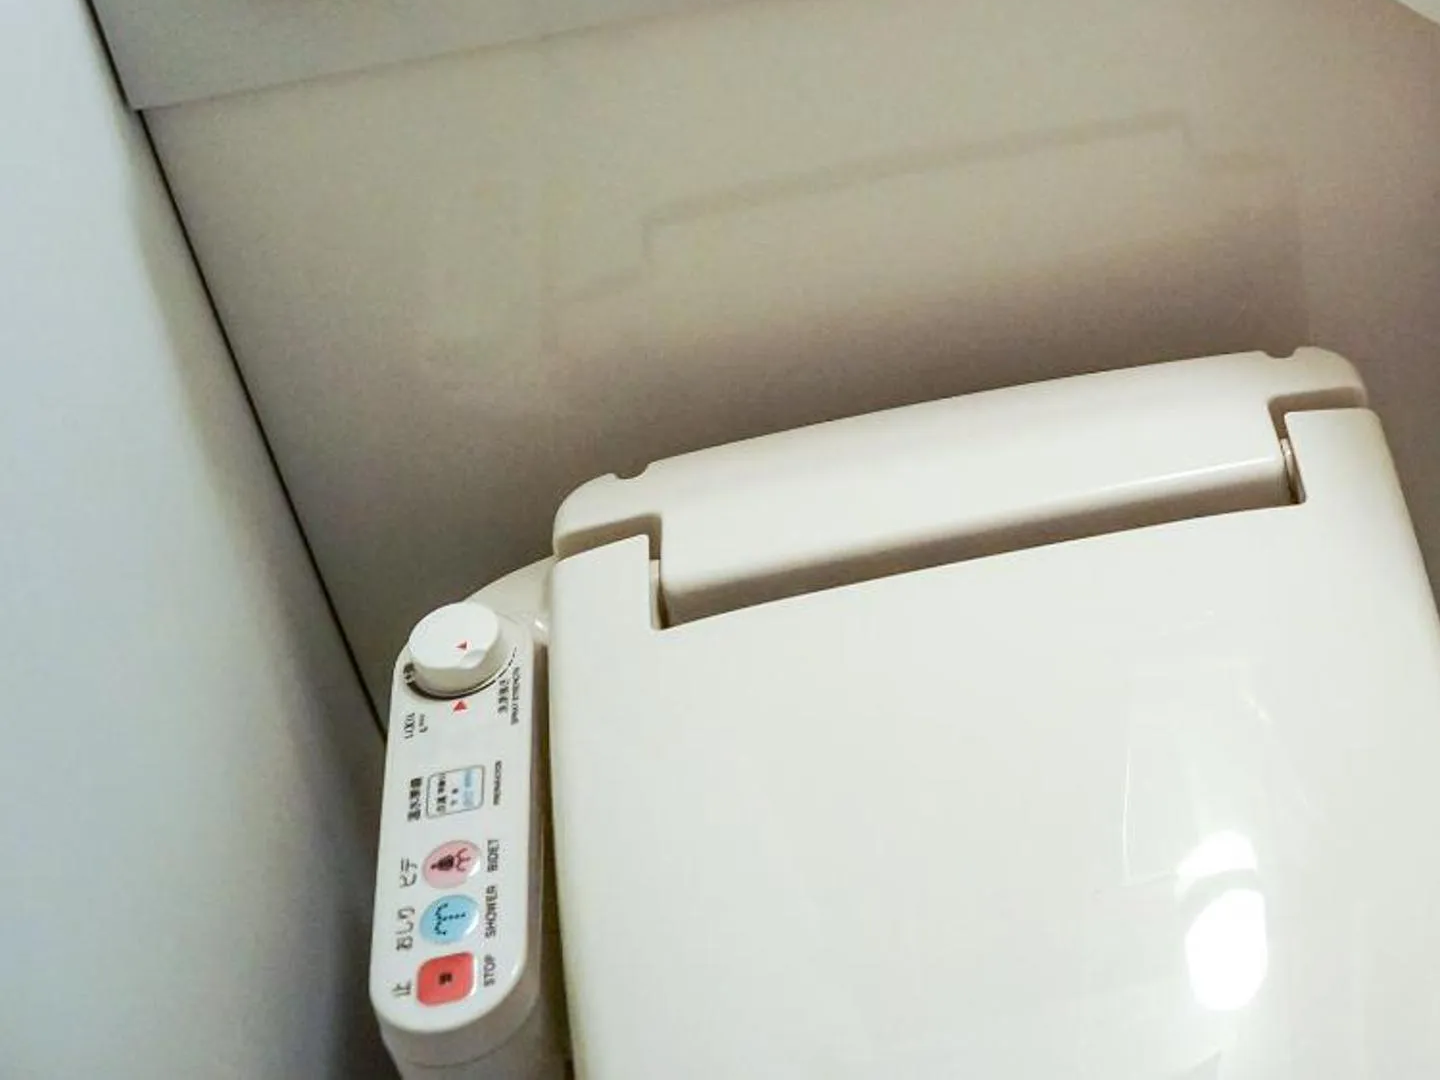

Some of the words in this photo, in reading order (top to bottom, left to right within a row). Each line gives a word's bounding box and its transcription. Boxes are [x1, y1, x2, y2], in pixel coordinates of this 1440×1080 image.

[487, 839, 499, 872] BIDET
[396, 906, 416, 951] おしり
[485, 885, 499, 938] SHOWER
[483, 954, 497, 987] STOP
